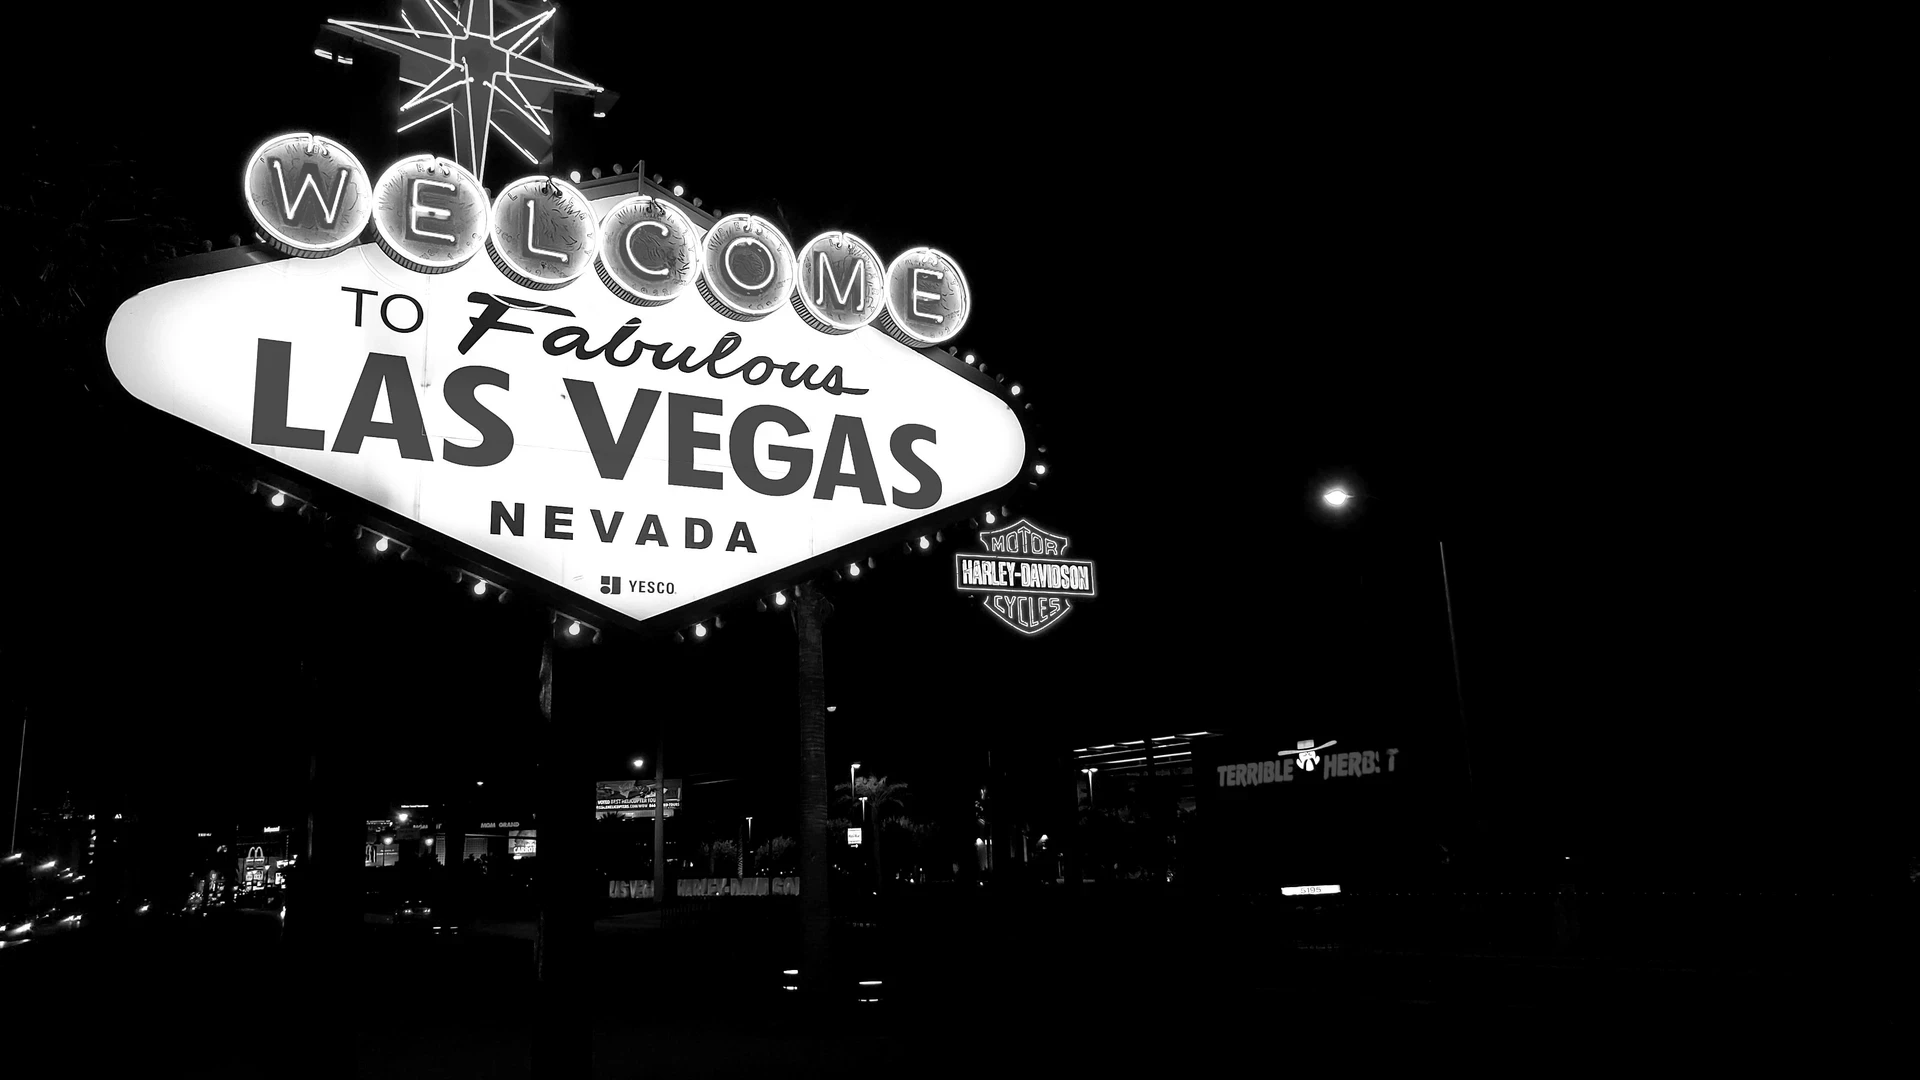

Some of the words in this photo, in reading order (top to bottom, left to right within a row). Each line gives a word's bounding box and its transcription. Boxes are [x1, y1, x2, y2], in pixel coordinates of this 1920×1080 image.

[262, 152, 948, 328] WELCOME
[340, 286, 425, 333] TO
[457, 290, 869, 396] Fabulous
[250, 337, 515, 468] LAS
[563, 377, 943, 510] VEGAS
[489, 500, 757, 553] NEVADA
[991, 526, 1059, 556] MOTOR
[629, 580, 675, 595] YESCO
[962, 559, 1090, 590] HARLEY-DAVIDSON
[993, 594, 1061, 628] CYCLES
[1216, 758, 1294, 788] TERRIBLE
